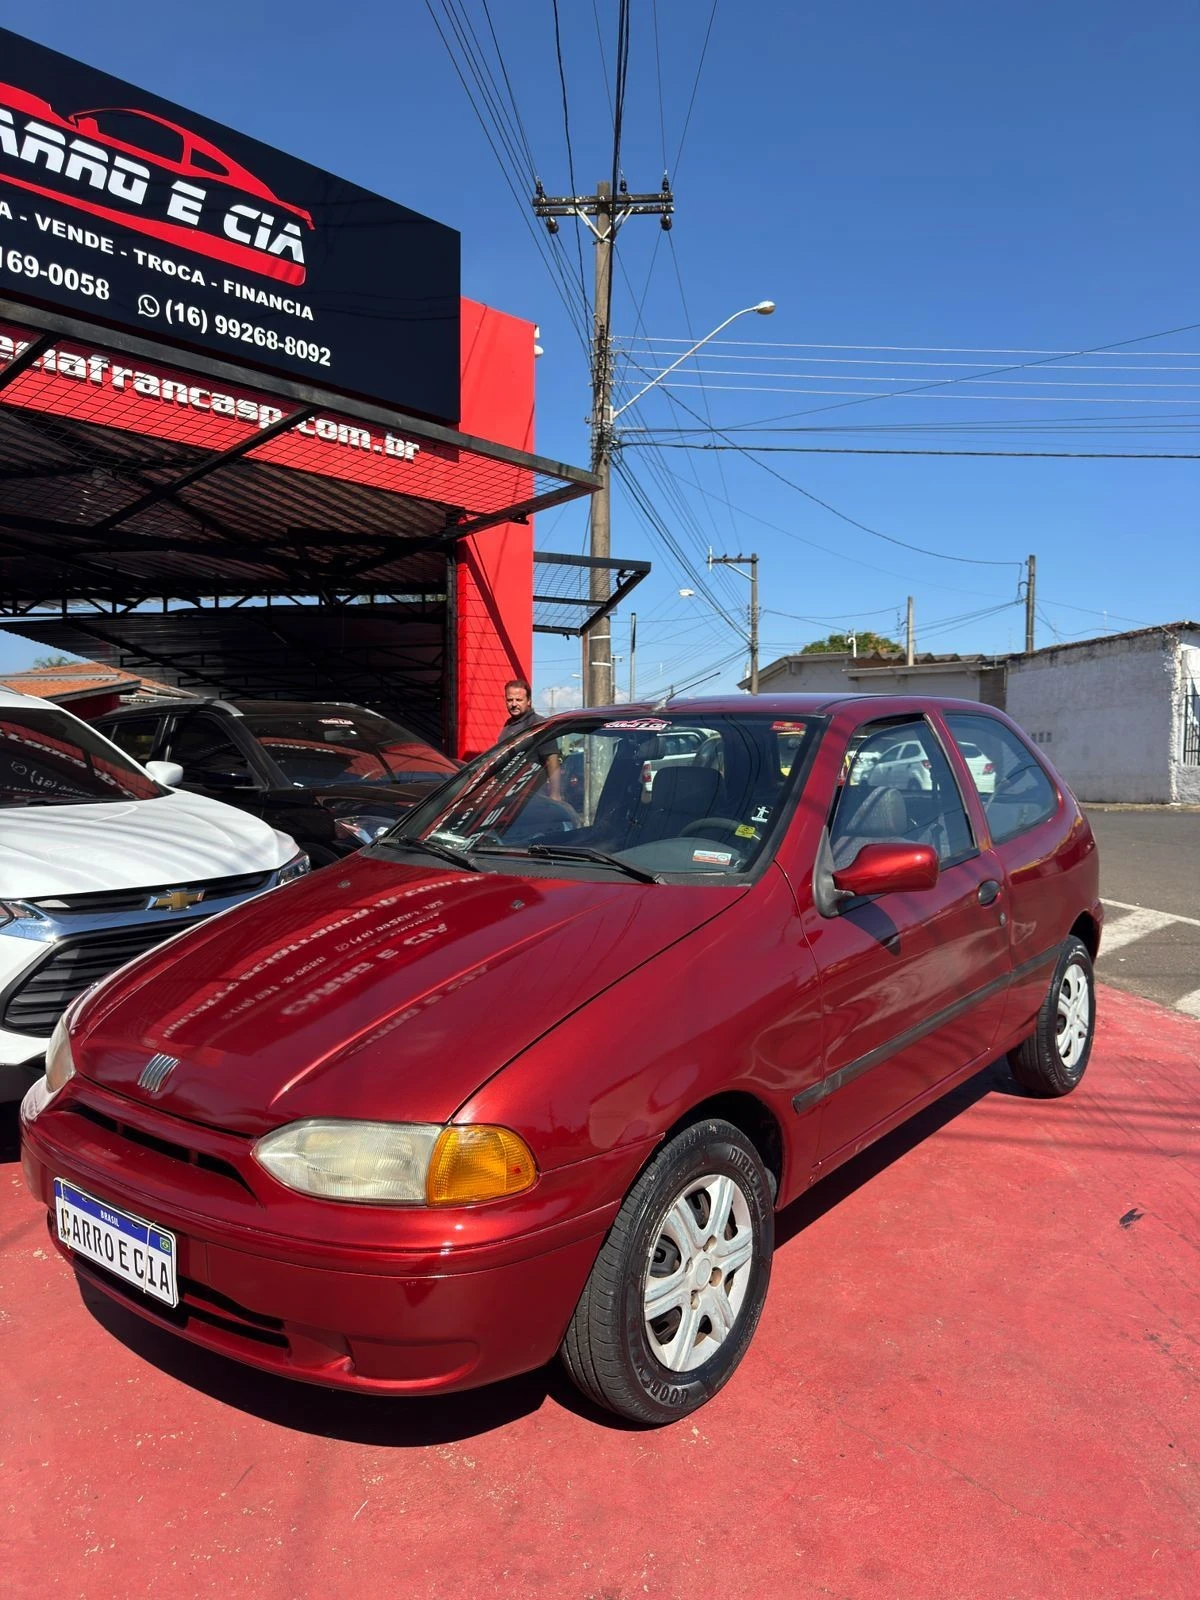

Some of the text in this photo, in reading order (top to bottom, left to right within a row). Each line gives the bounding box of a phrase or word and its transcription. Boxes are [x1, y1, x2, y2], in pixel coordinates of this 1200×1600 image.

[167, 180, 207, 226] E
[223, 204, 305, 264] CIA
[35, 212, 114, 255] VENDE
[134, 248, 206, 287] TROCA
[223, 279, 314, 321] FINANCIA
[165, 298, 332, 367] (16) 99268-8092
[100, 1209, 120, 1228] BRASIL
